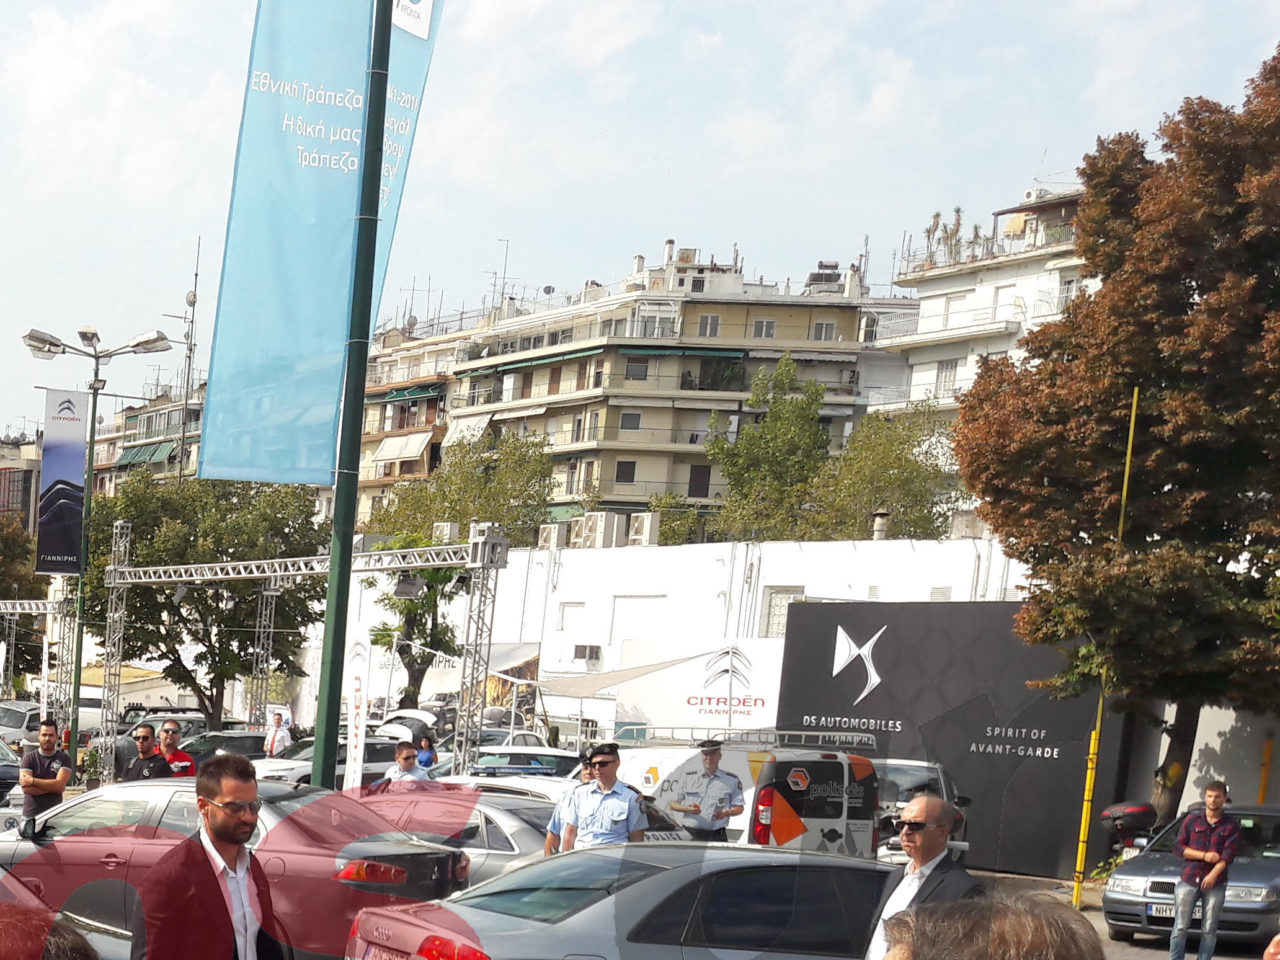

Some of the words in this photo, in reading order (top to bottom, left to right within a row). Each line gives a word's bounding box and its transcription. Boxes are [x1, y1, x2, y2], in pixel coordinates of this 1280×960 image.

[251, 70, 298, 99] Εθνική
[301, 82, 363, 111] Τράπεζα
[281, 113, 294, 132] Η
[295, 117, 325, 139] δική
[328, 126, 361, 146] μας
[296, 145, 358, 173] Τράπεζα
[699, 708, 752, 716] ΓΙΑΝΝΡΗΣ
[803, 715, 817, 726] DS
[820, 716, 902, 731] AUTOMOBILES
[986, 727, 1027, 738] SPIRIT
[1030, 729, 1047, 740] OF
[969, 743, 1060, 758] AVANT-GARDE
[644, 833, 682, 841] POLICE
